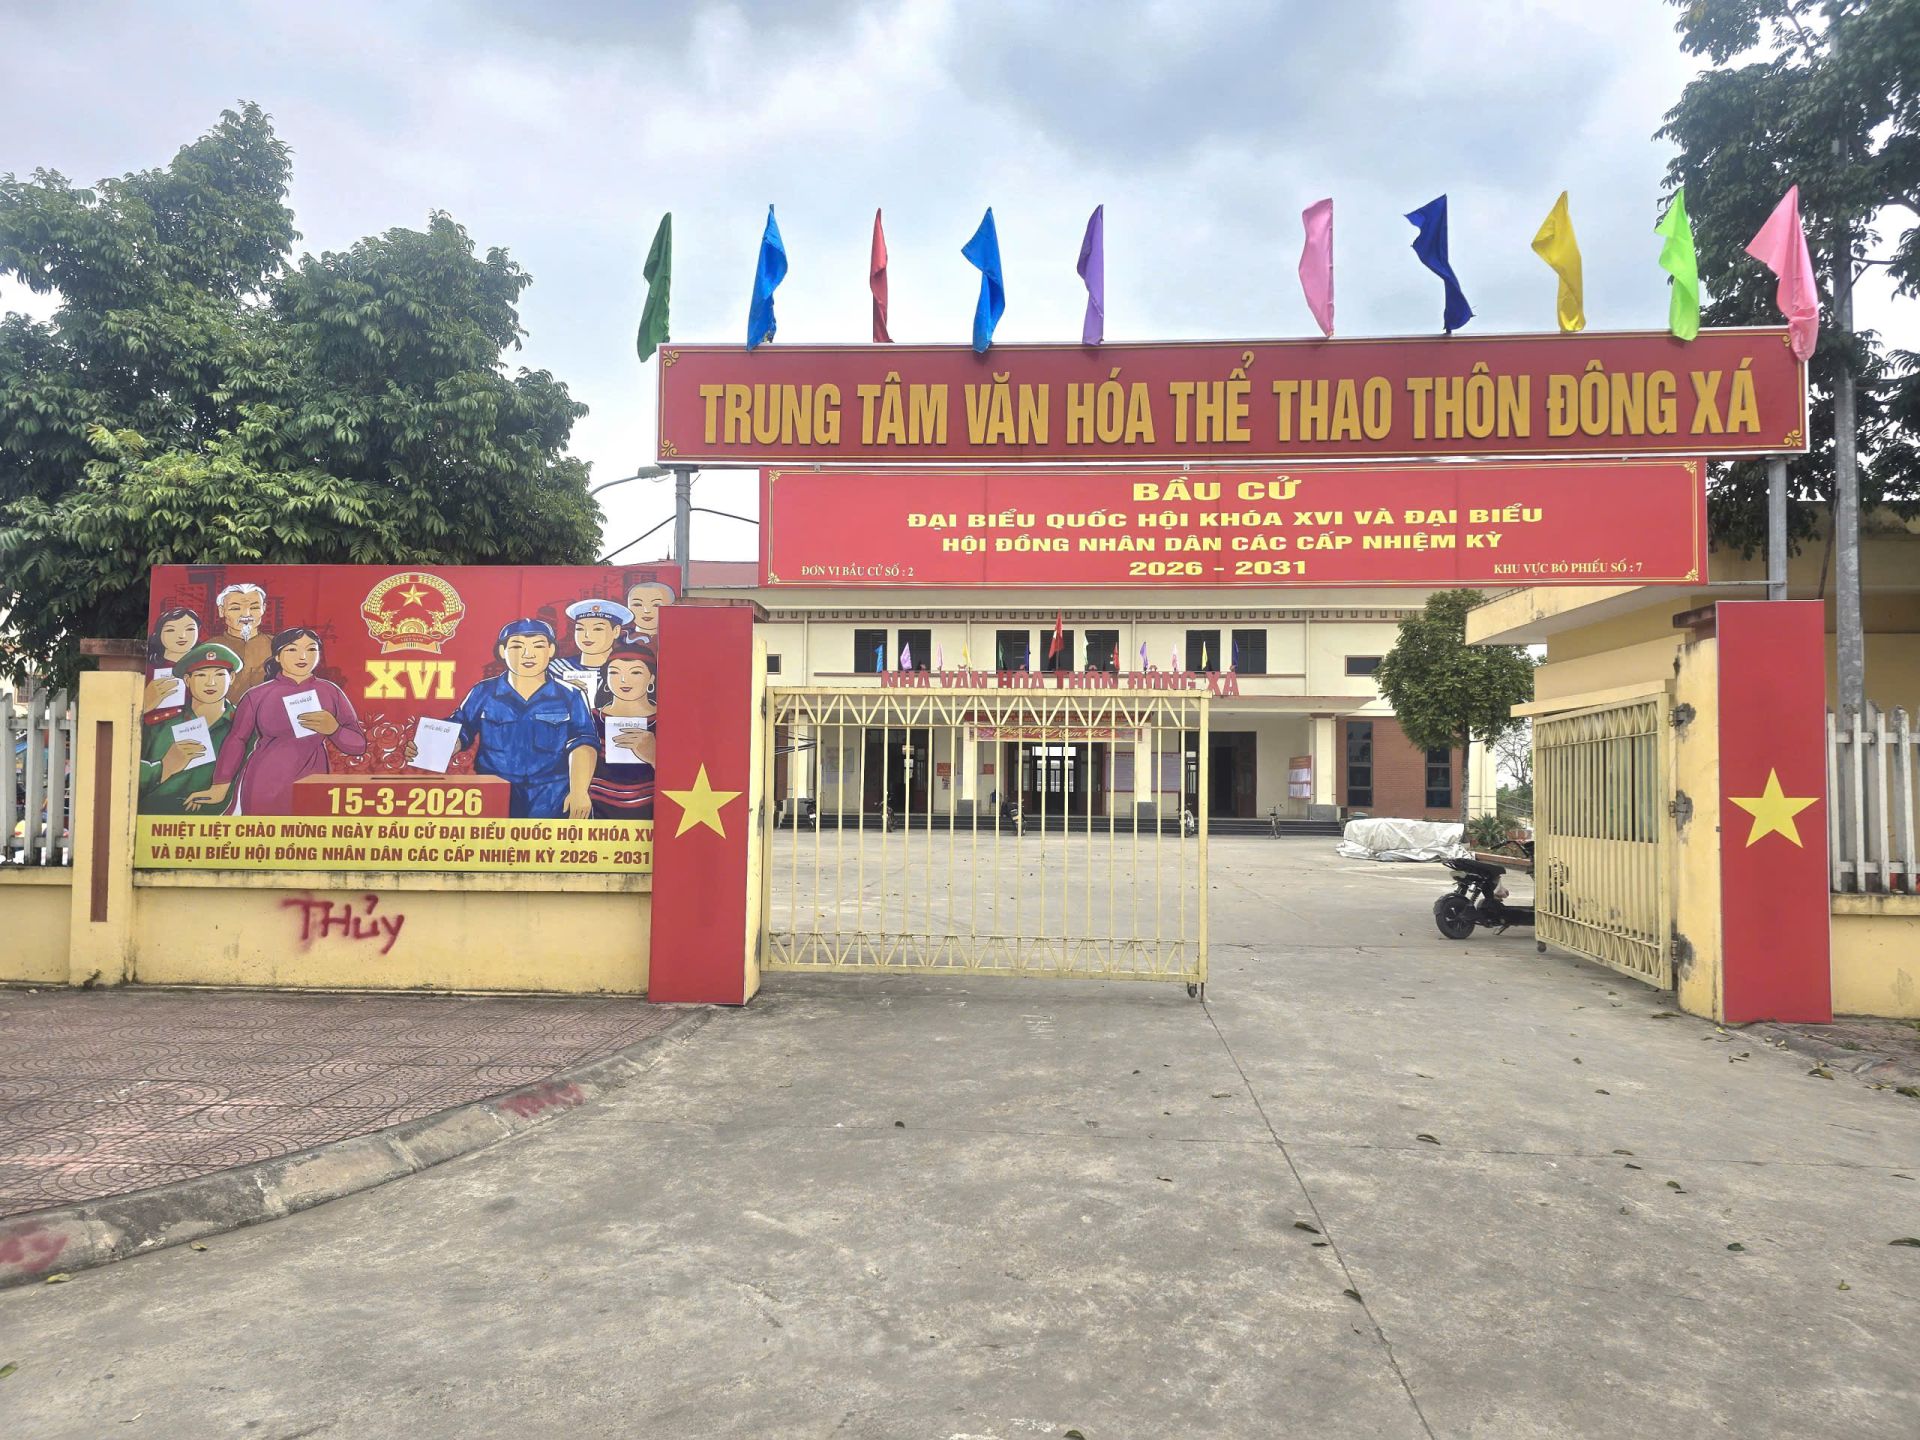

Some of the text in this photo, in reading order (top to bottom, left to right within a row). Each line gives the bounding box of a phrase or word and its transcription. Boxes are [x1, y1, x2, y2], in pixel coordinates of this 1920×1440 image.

[699, 350, 1761, 445] TRUNG TÂM VĂN HÓA THỂ THAO THÔN ĐÔNG XÁ
[1133, 475, 1302, 501] BẦU CỬ
[907, 503, 1543, 531] ĐẠI BIỂU QUỐC HỘI KHÓA XVI VÀ ĐẠI BIỂU
[943, 531, 1503, 554] HỘI ĐỒNG NHÂN DÂN CÁC CẤP NHIỆM KỲ
[801, 564, 825, 575] ĐƠN
[885, 562, 900, 576] SỐ
[908, 567, 914, 576] 2
[1129, 562, 1203, 576] 2026
[1235, 560, 1306, 575] 2031
[1494, 563, 1520, 574] KHU
[1522, 562, 1549, 575] VỰC
[1571, 558, 1608, 573] PHIẾU
[1610, 558, 1627, 573] SỐ
[1636, 562, 1643, 572] 7
[364, 659, 456, 699] XVI
[881, 664, 1240, 696] NHÀ VĂN HÓA THÔN ĐÔNG XÁ
[327, 787, 483, 816] 15-3-2026
[151, 821, 654, 844] NHIỆT LIỆT CHÀO MỪNG NGÀY BẦU CỬ ĐẠI BIỂU QUỐC HỘI KHÓA XV
[151, 843, 170, 859] VÀ
[175, 846, 201, 862] ĐẠI
[205, 841, 240, 860] BIỂU
[245, 844, 270, 863] HỘI
[275, 842, 317, 860] ĐỒNG
[322, 845, 366, 861] NHÂN
[371, 845, 403, 861] DÂN
[407, 845, 439, 862] CÁC
[443, 843, 475, 862] CẤP
[479, 847, 531, 865] NHIỆM
[535, 847, 555, 863] KỲ
[559, 850, 598, 864] 2026
[613, 850, 650, 864] 2031
